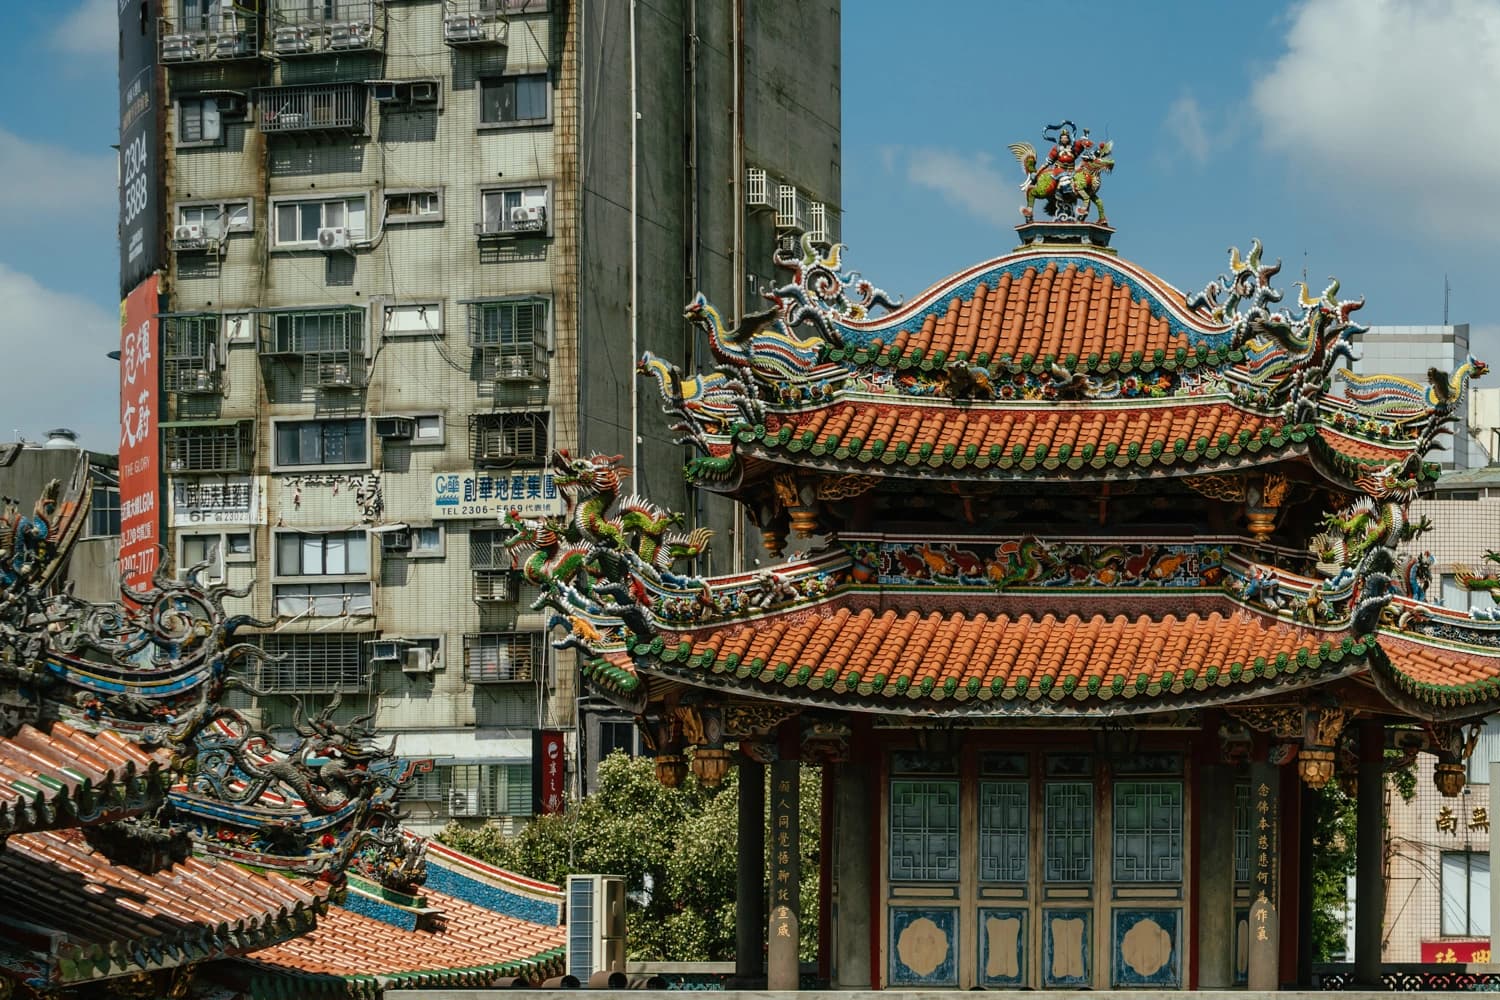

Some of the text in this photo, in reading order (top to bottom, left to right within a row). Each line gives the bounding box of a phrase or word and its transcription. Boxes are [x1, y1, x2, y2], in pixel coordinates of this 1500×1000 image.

[125, 130, 147, 187] 2304
[125, 173, 148, 225] 5888
[124, 462, 134, 479] THE
[463, 474, 557, 502] 創華地產集團
[190, 510, 212, 523] 6F
[441, 504, 523, 515] TEL 2306-5669
